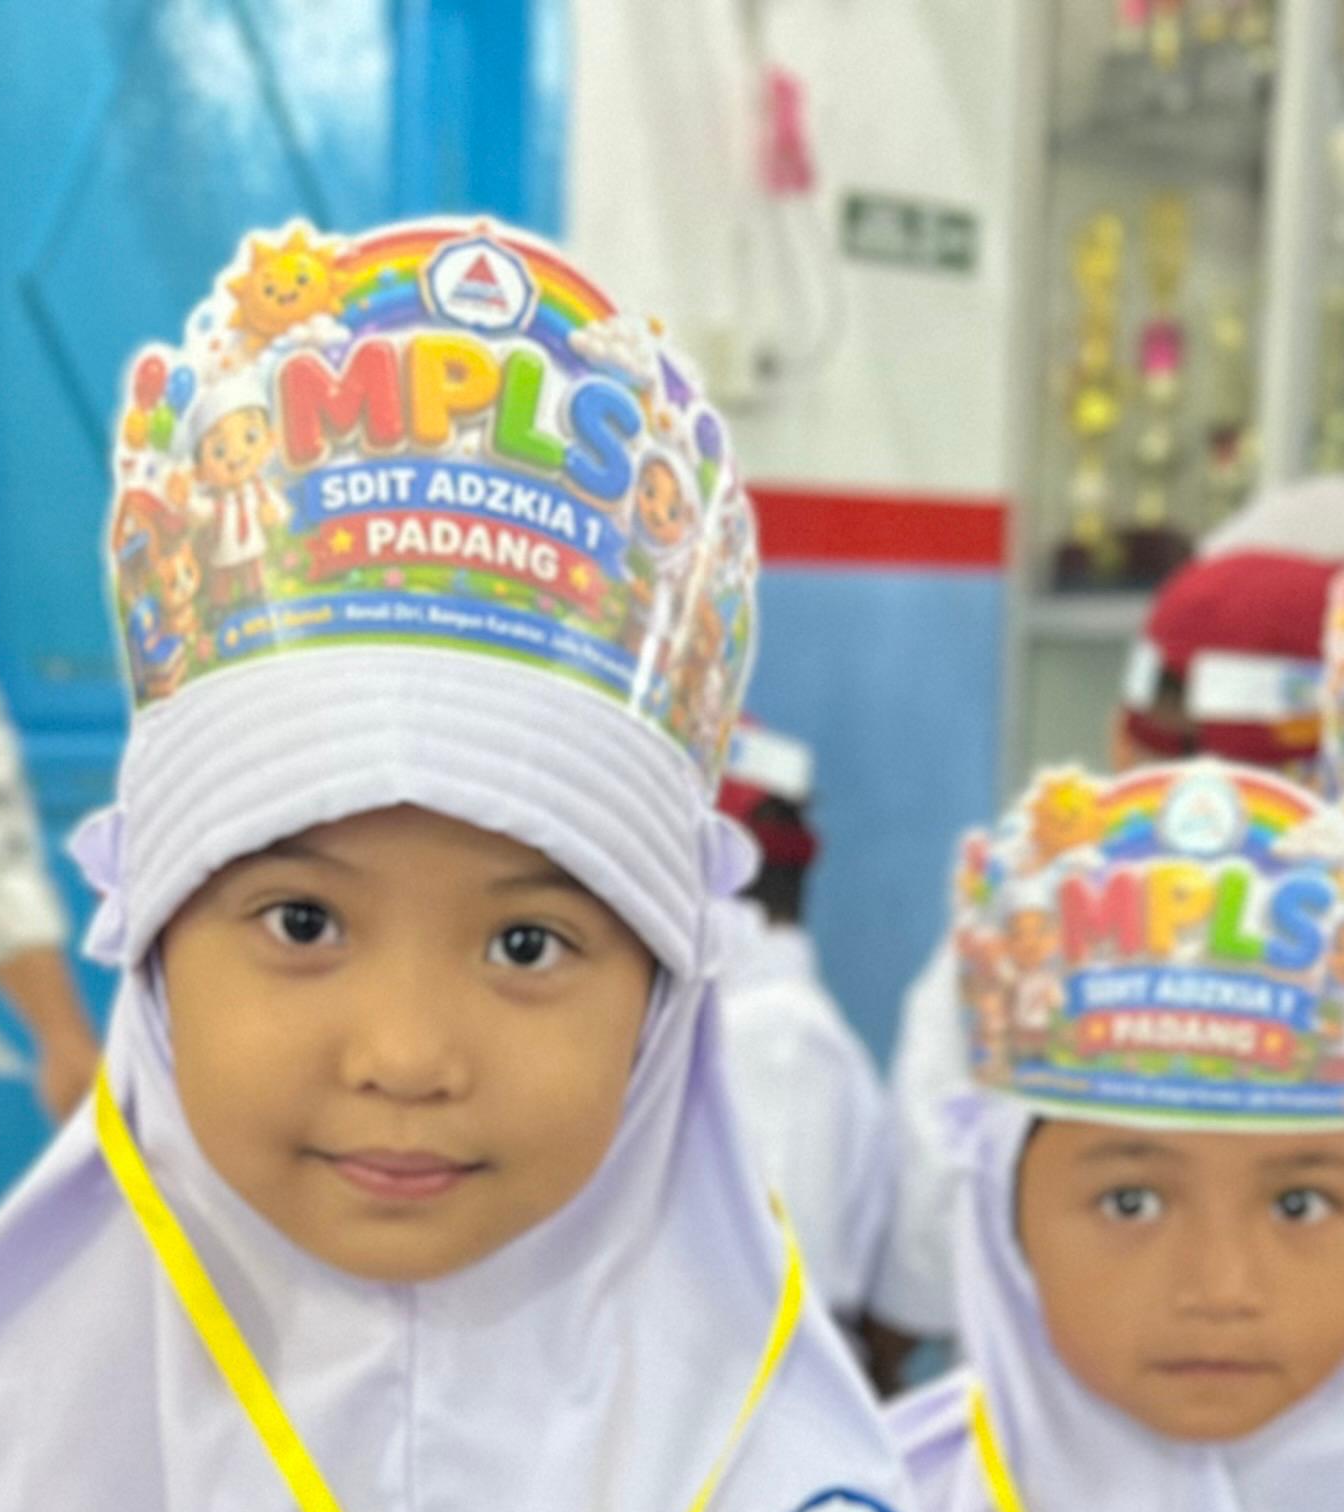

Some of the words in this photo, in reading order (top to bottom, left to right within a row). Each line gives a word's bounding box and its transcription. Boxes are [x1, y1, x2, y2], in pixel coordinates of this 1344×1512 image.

[280, 335, 640, 500] MPLS
[321, 468, 416, 511] SDIT
[427, 469, 577, 539] ADZKIA
[585, 516, 602, 549] 1
[366, 517, 560, 582] PADANG
[1061, 862, 1334, 970] MPLS
